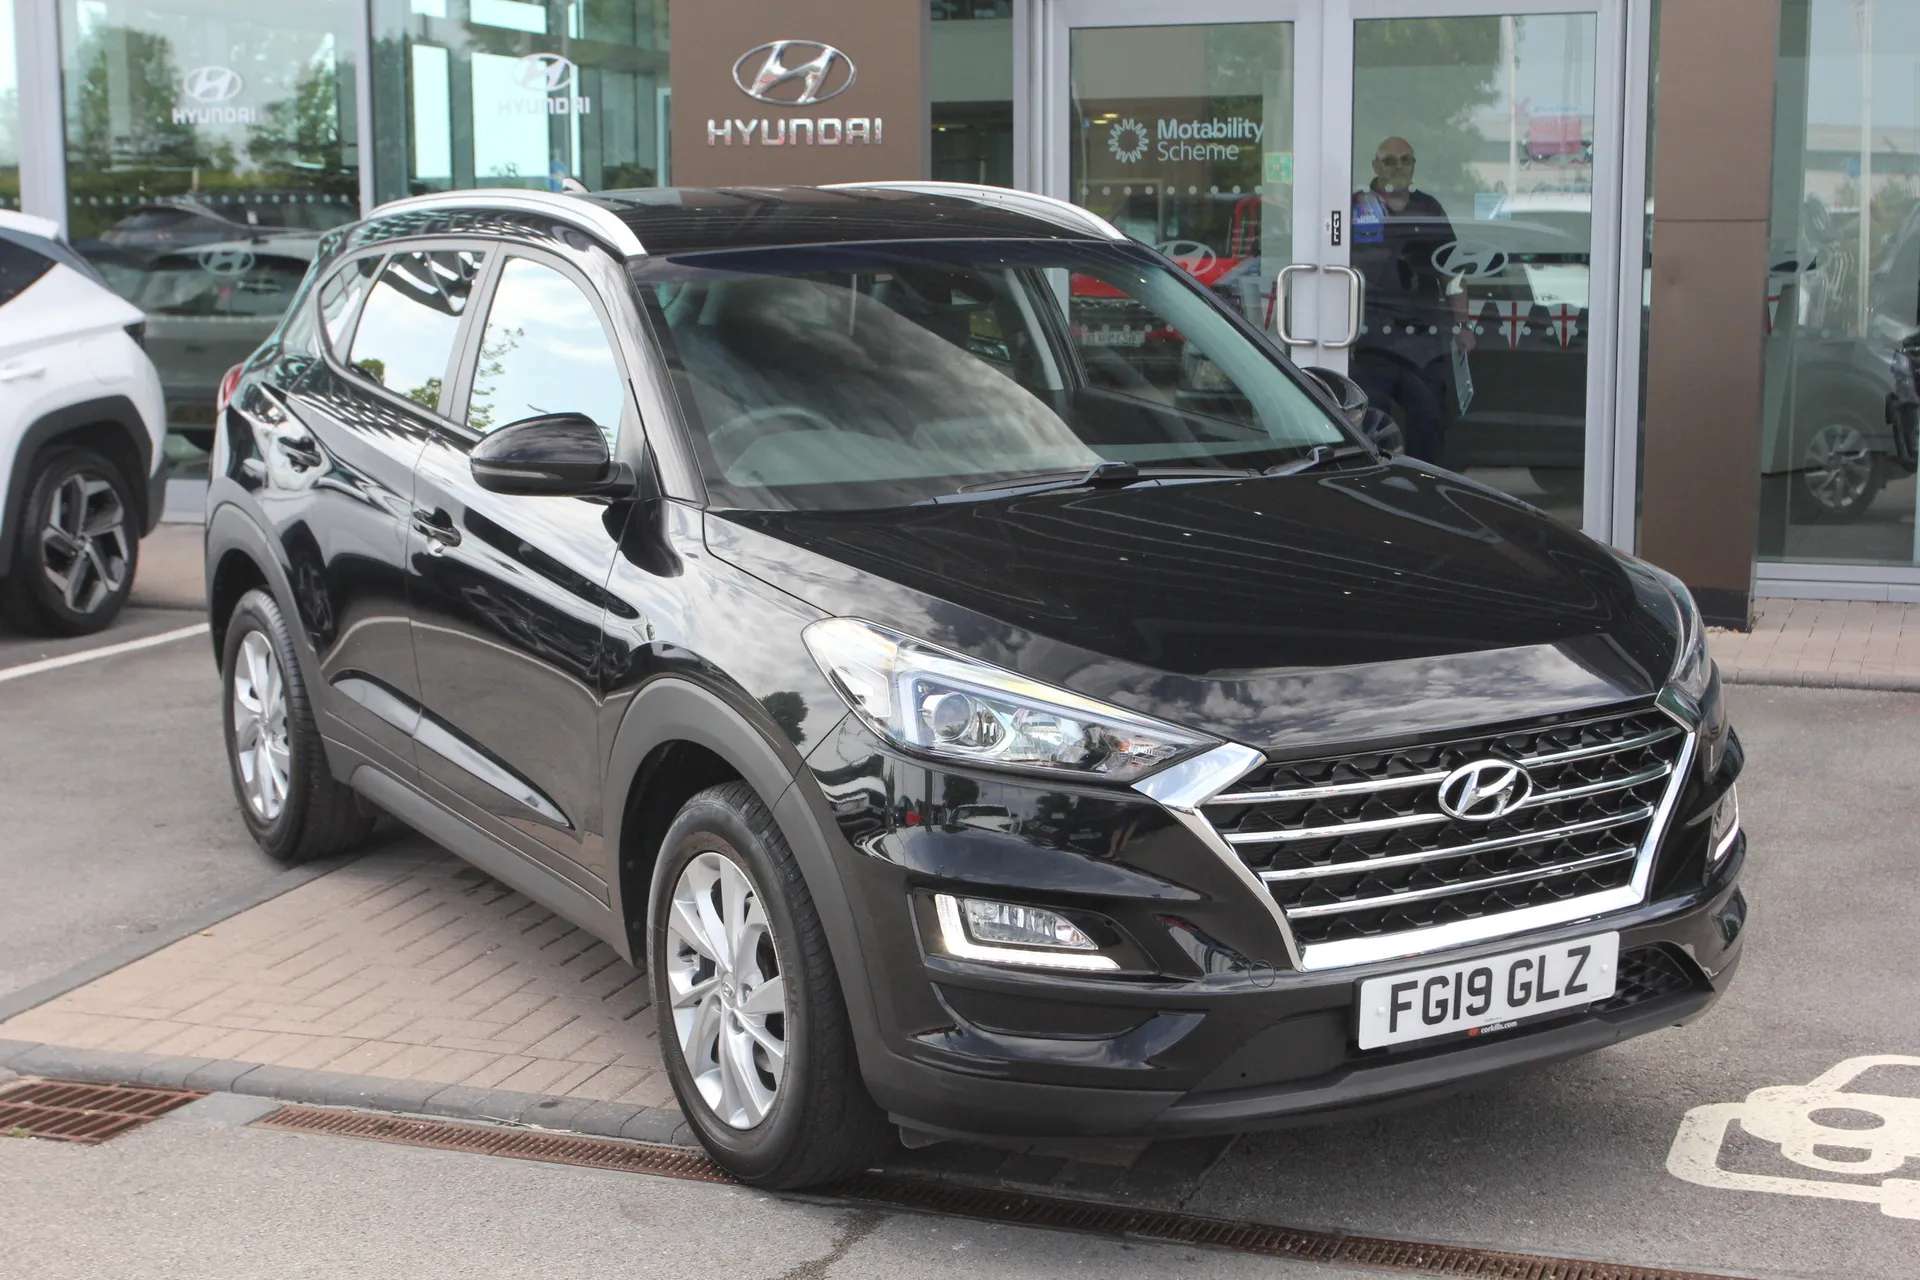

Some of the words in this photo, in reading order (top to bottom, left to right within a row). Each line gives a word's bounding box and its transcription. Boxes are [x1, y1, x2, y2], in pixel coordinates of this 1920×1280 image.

[172, 107, 256, 124] HYUNDAI
[706, 117, 883, 146] HYUNDAI
[1156, 116, 1264, 143] Motability
[1156, 140, 1240, 161] Scheme
[1389, 966, 1493, 1033] FG19
[1507, 944, 1592, 1008] GLZ
